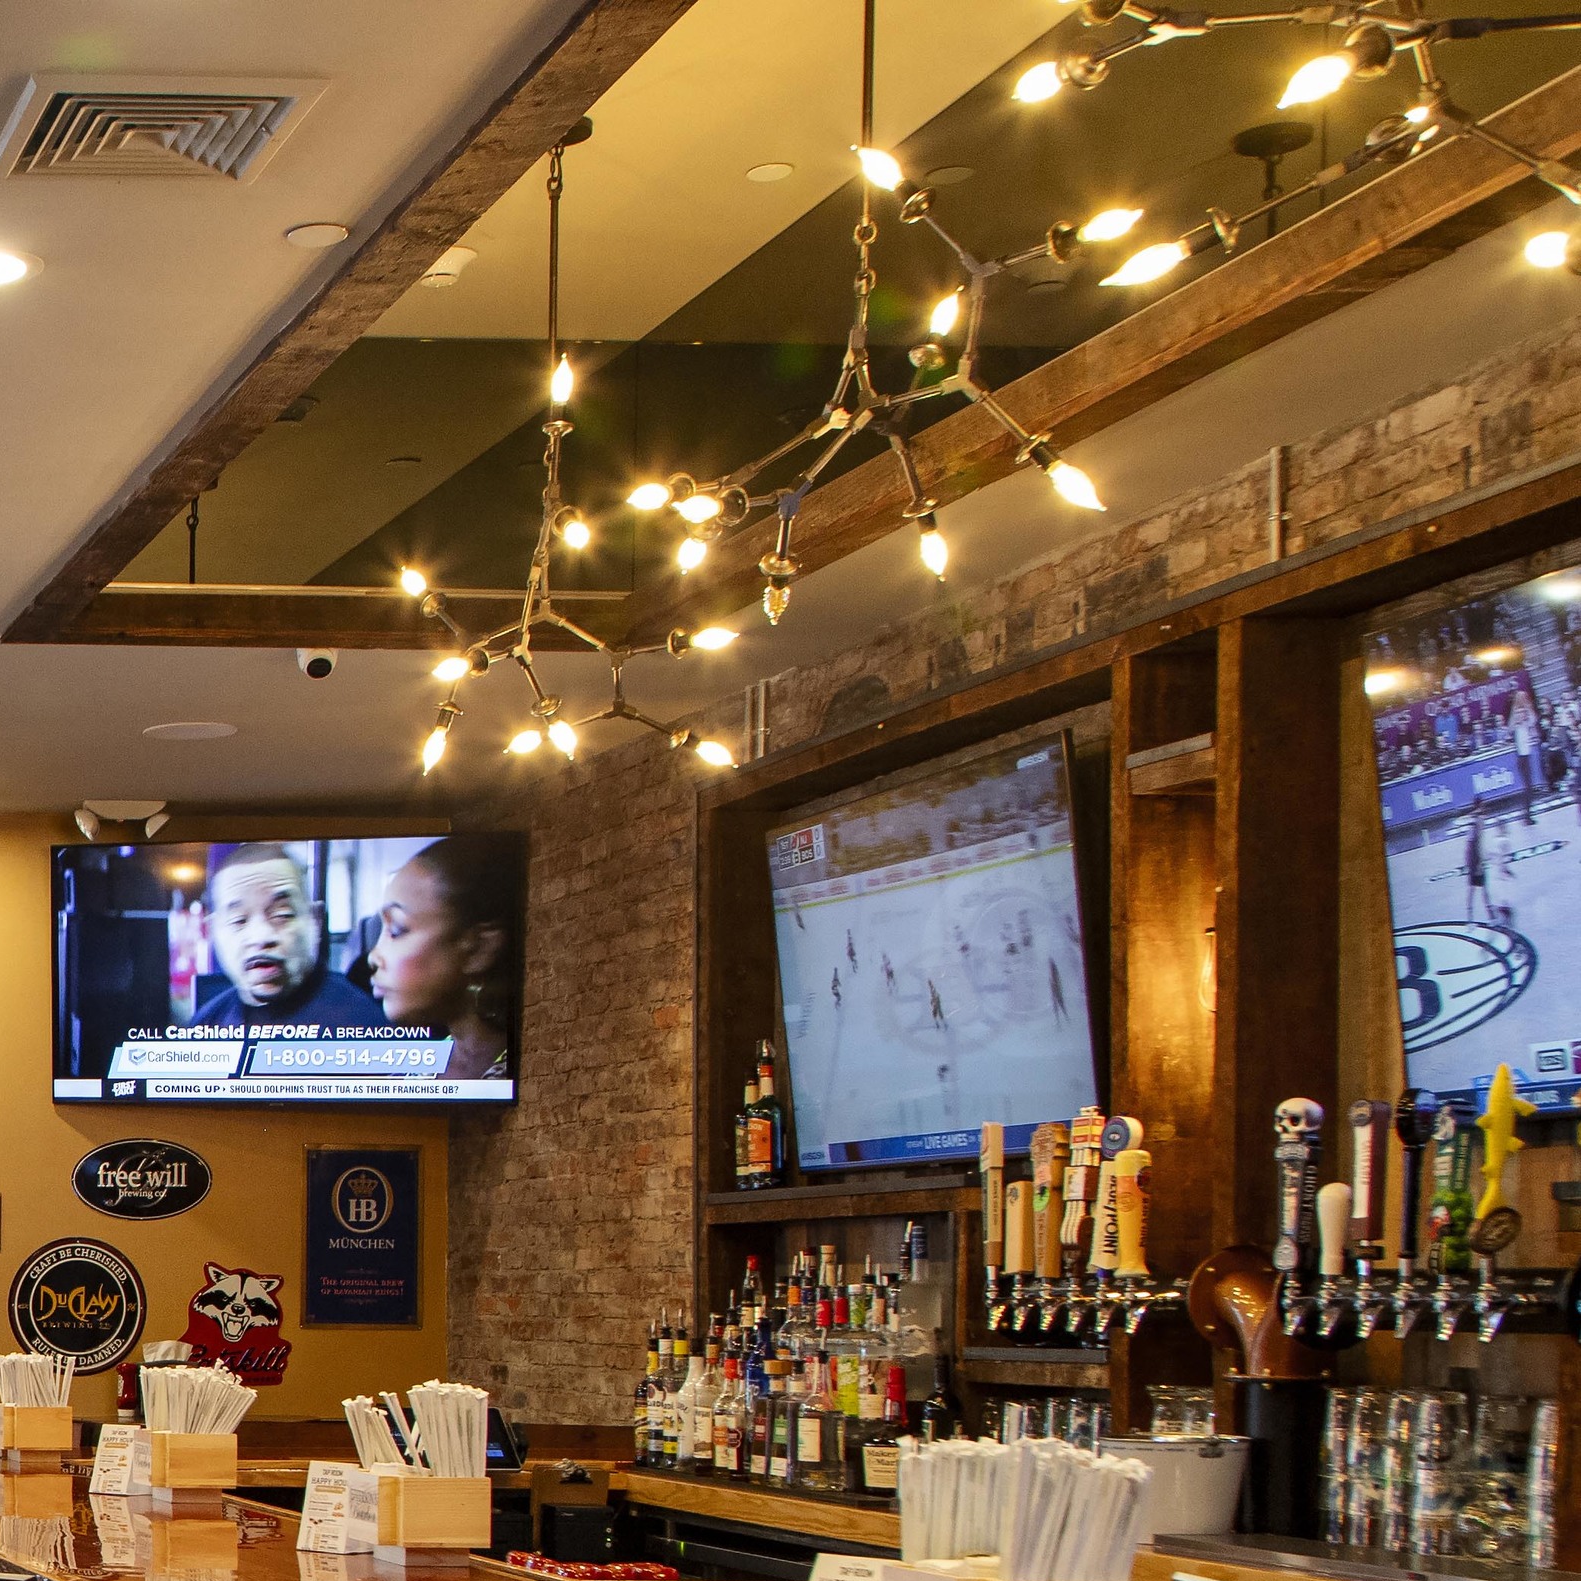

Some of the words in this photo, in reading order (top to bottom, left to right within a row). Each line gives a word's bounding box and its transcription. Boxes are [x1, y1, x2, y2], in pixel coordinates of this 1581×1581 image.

[128, 1028, 162, 1039] CALL
[165, 1025, 245, 1040] CarShield
[248, 1025, 320, 1039] BEFORE
[322, 1027, 332, 1039] A
[336, 1026, 431, 1039] BREAKDOWN
[147, 1051, 230, 1063] CarShield.com
[264, 1048, 437, 1067] 1-800-514-4796
[154, 1084, 201, 1093] COMING
[204, 1084, 221, 1093] UP
[229, 1084, 262, 1094] SHOULD
[264, 1084, 305, 1094] DOLPHINS
[307, 1084, 333, 1094] TRUST
[335, 1084, 351, 1094] TUA
[353, 1084, 364, 1094] AS
[366, 1084, 390, 1094] THEIR
[392, 1084, 440, 1094] FRANCHISE
[442, 1084, 459, 1094] QB?
[942, 1132, 968, 1149] GAMES
[97, 1161, 142, 1188] free
[144, 1162, 188, 1188] will
[118, 1188, 154, 1199] brewing
[348, 1198, 379, 1222] HB
[328, 1237, 396, 1249] MÜNCHEN
[29, 1253, 58, 1280] CRAFT
[58, 1248, 73, 1260] BE
[74, 1247, 129, 1284] CHERISHED.
[78, 1338, 126, 1366] DAMNED.
[333, 1478, 348, 1487] HOU
